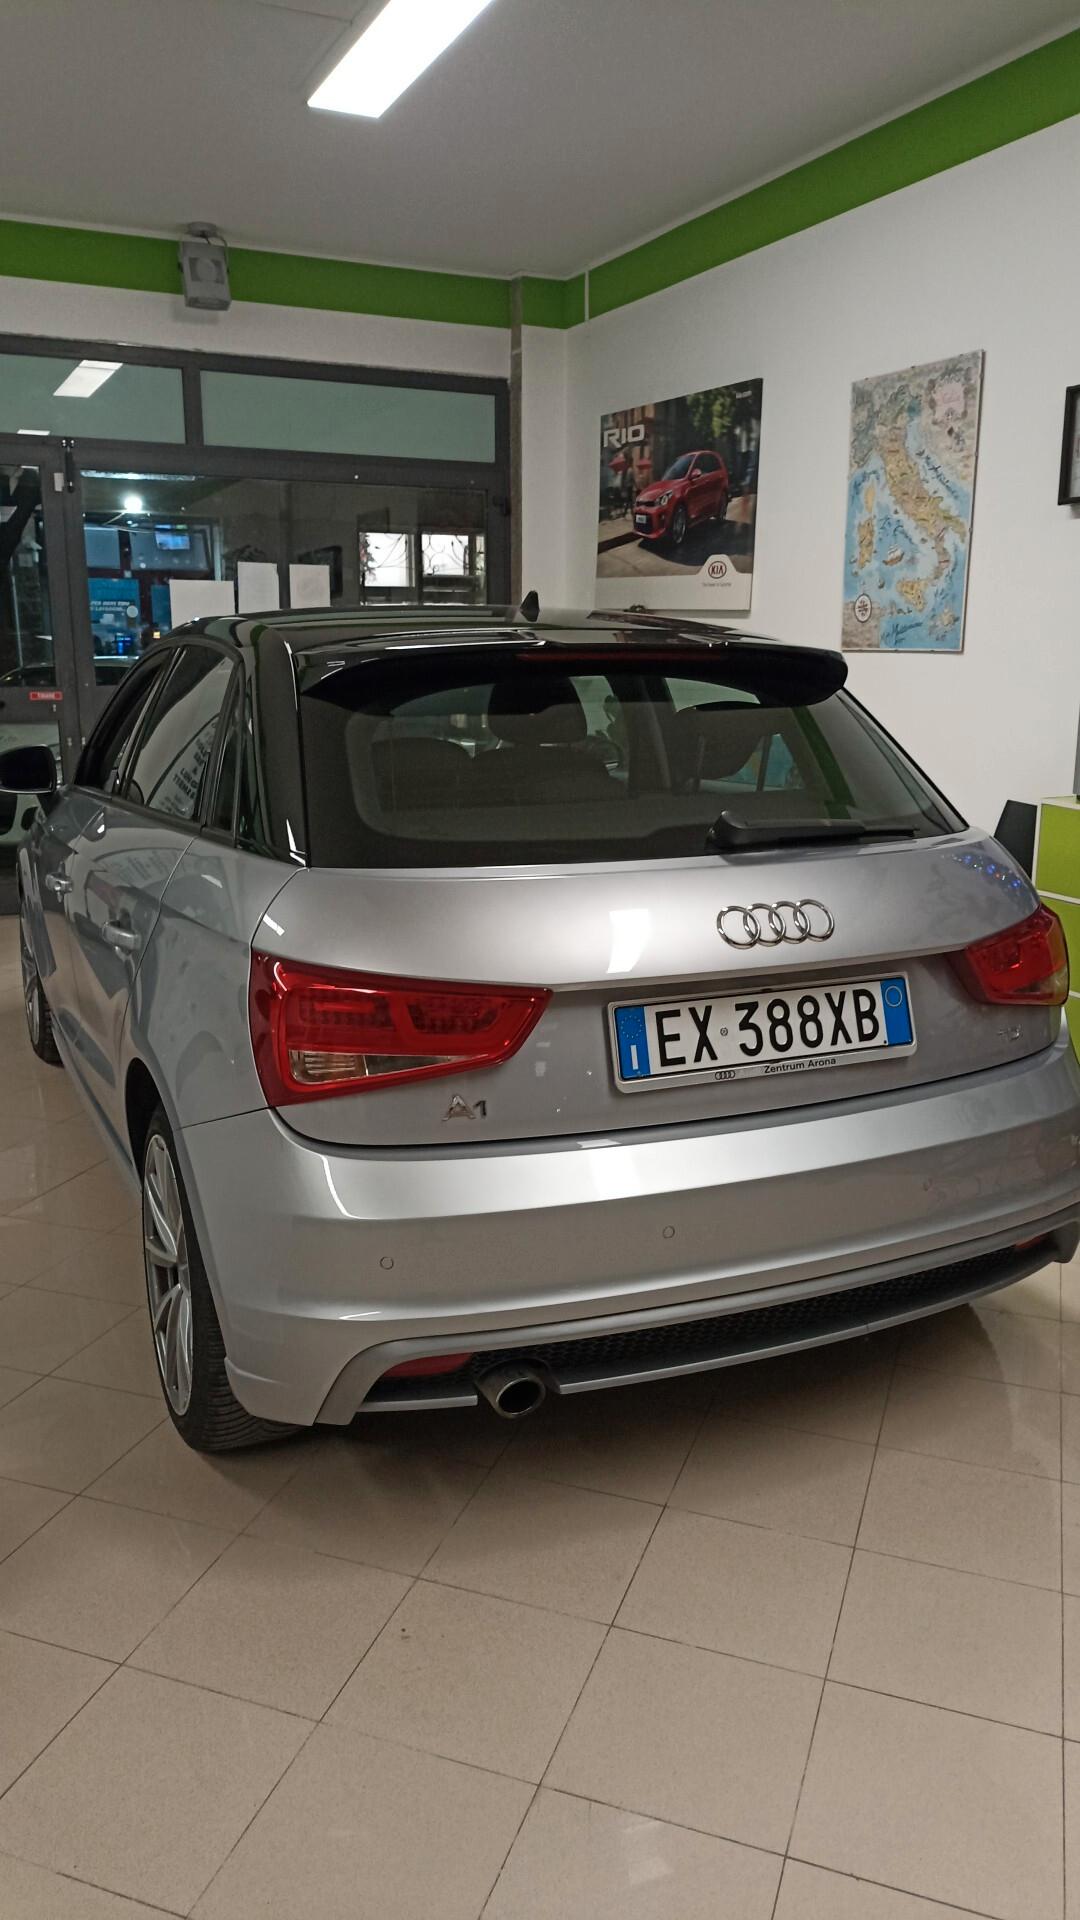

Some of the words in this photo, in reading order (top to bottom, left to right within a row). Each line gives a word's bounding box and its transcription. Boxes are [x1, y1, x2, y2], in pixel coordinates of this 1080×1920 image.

[603, 424, 645, 448] RIO
[655, 1005, 718, 1067] EX
[735, 989, 879, 1056] 388XB
[764, 1062, 805, 1074] Zentrum
[808, 1058, 837, 1068] Arona
[441, 1095, 487, 1121] A1
